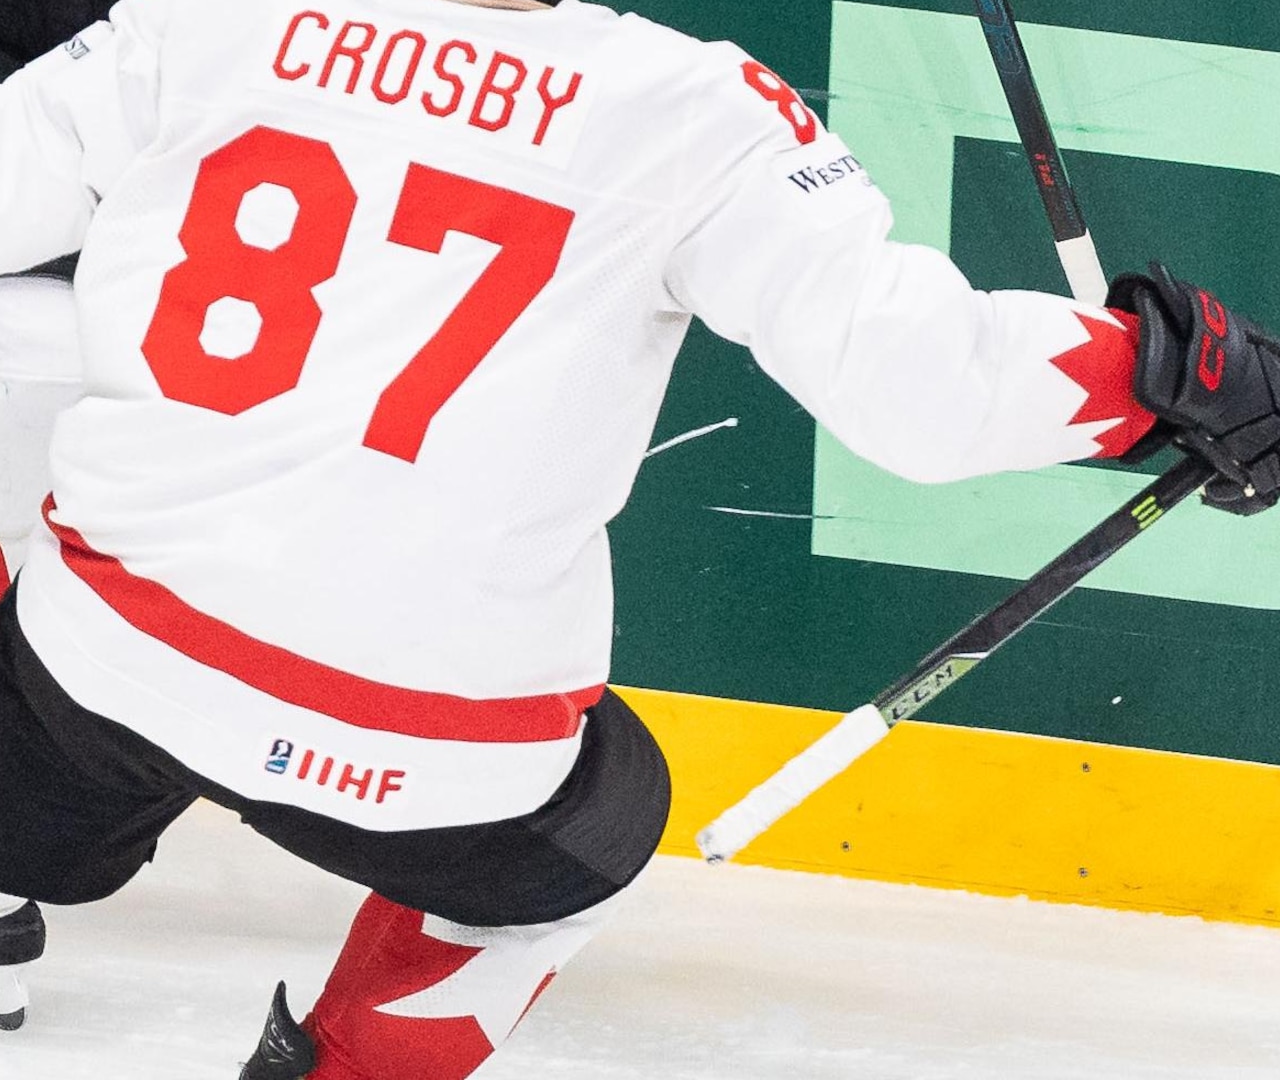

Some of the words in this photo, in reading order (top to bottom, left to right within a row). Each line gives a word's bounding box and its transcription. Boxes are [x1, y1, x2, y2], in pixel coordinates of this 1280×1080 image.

[272, 10, 583, 146] CROSBY
[140, 124, 576, 464] 87
[892, 665, 952, 720] CCM
[297, 749, 406, 804] IIHF
